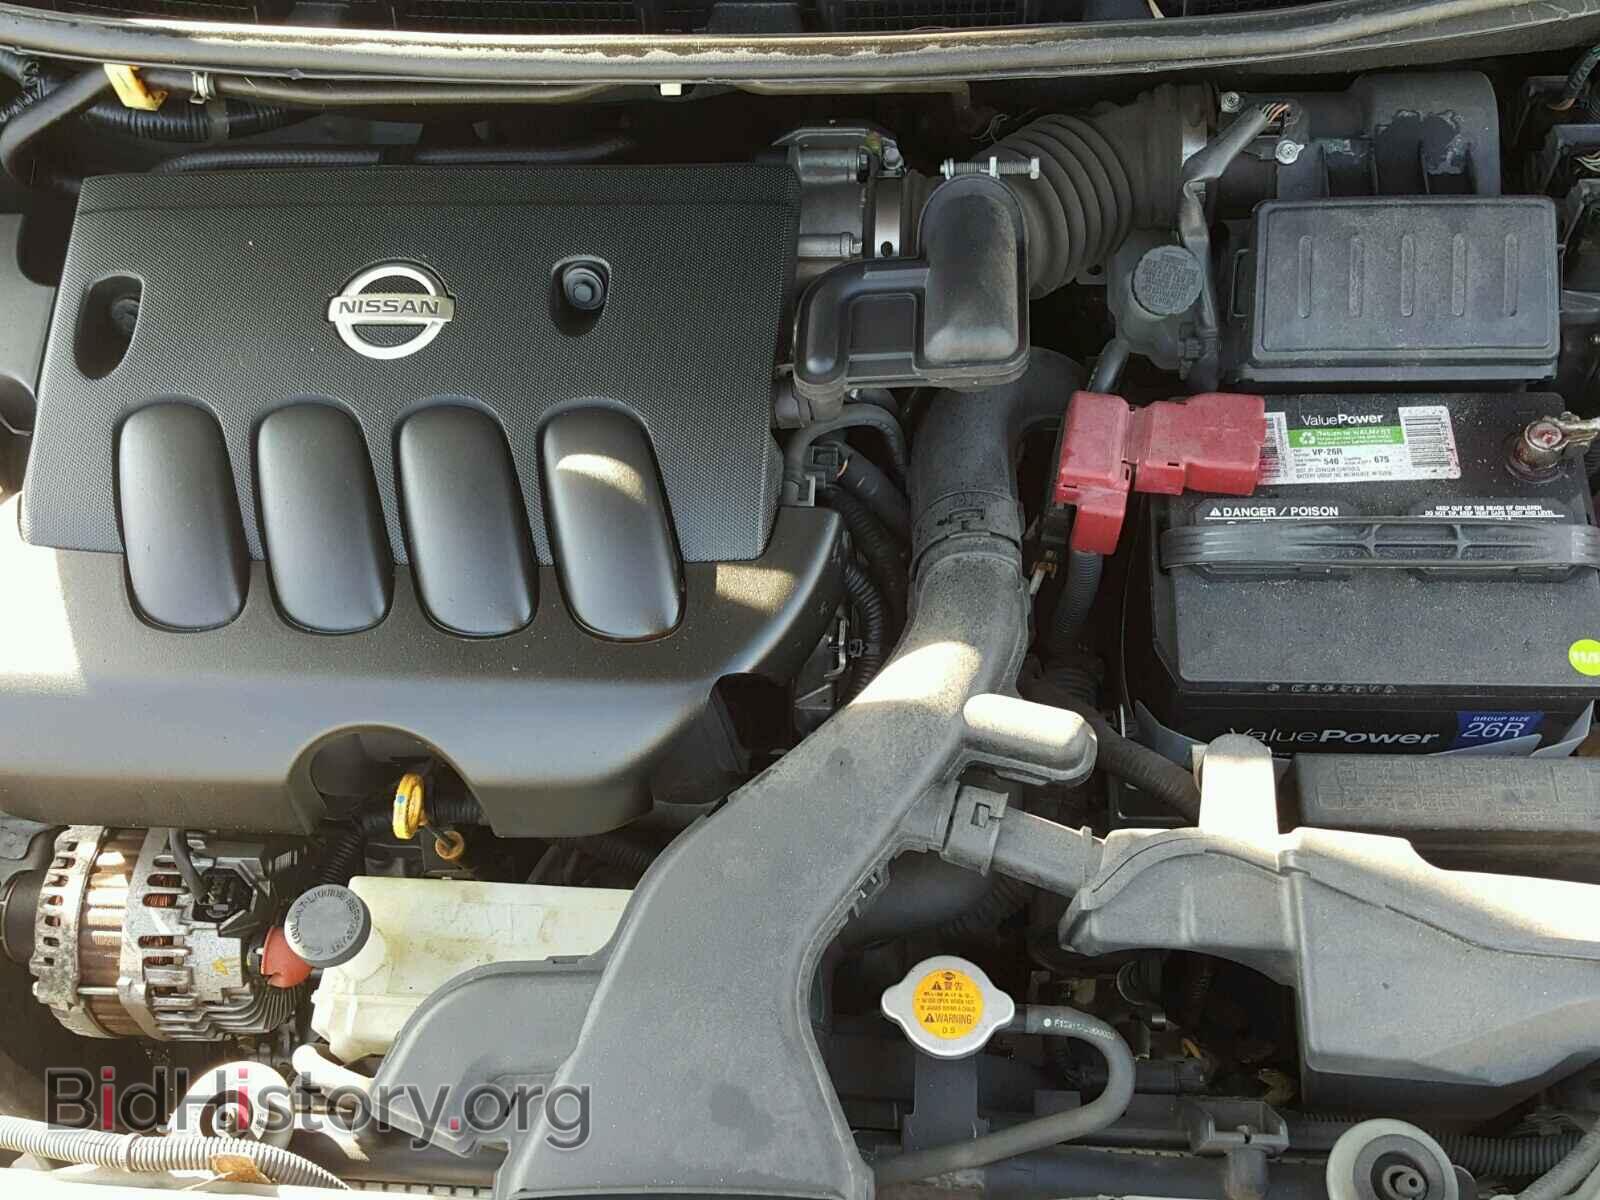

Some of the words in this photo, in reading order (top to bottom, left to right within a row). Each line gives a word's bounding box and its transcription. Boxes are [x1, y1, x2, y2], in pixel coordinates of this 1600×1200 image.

[339, 299, 440, 314] NISSAN
[1301, 413, 1384, 426] ValuePower
[1223, 506, 1277, 517] DANGER
[1290, 506, 1339, 517] POISON
[1461, 721, 1527, 738] 26R
[935, 1012, 972, 1025] WARNING
